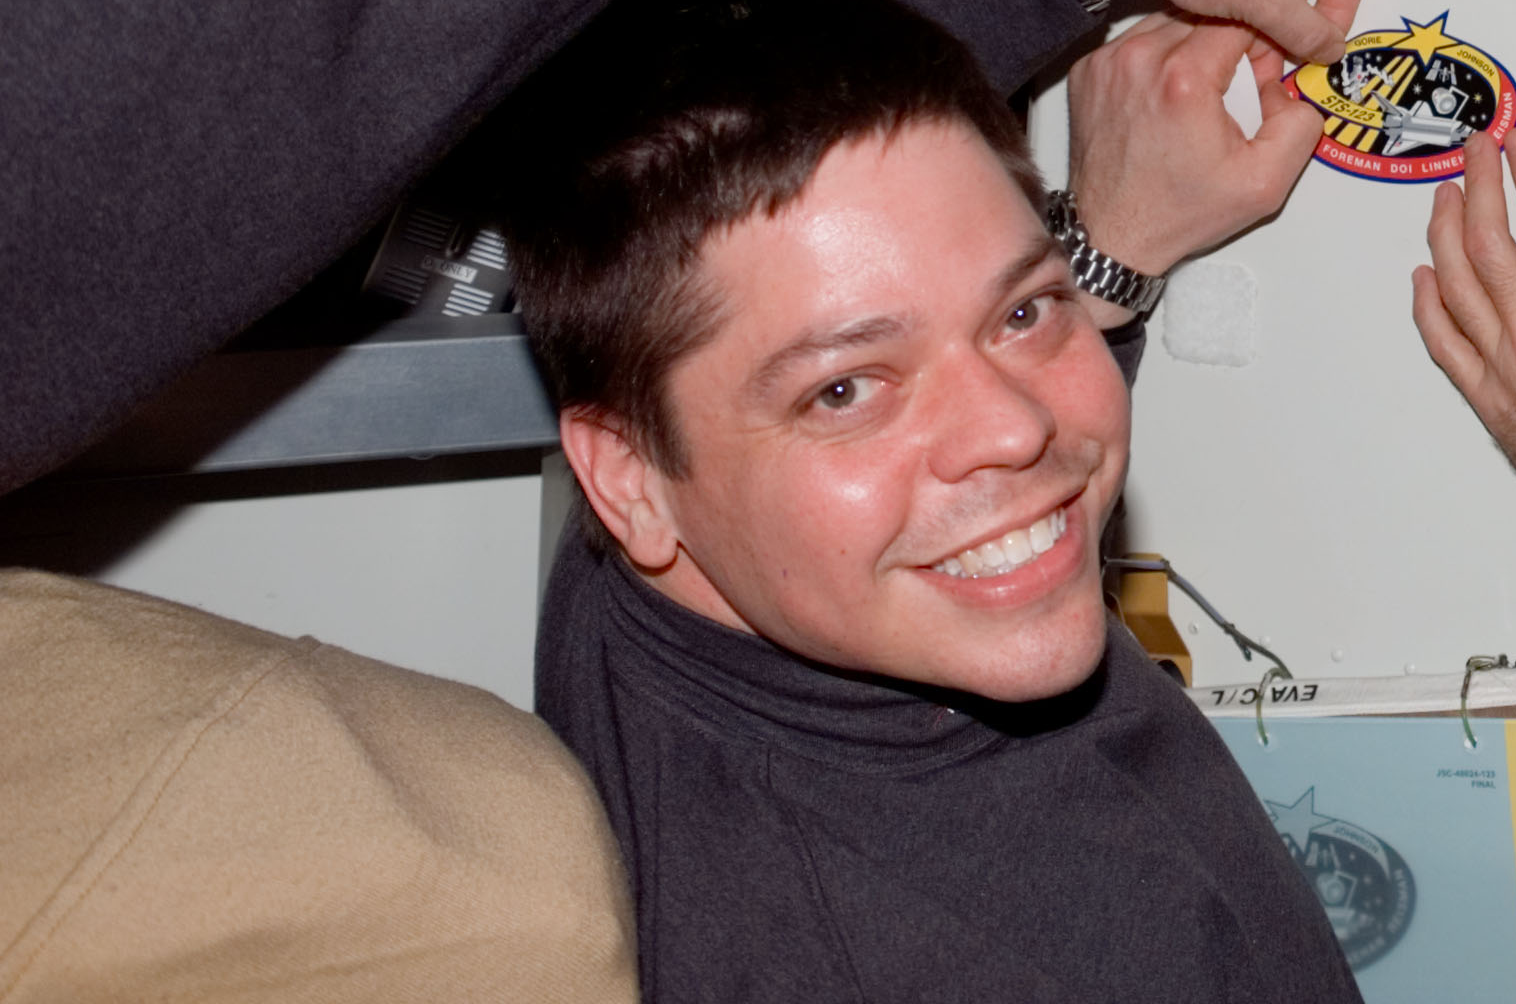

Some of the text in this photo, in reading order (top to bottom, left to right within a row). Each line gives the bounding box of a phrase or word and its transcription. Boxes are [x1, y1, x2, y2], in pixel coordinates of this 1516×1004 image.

[1456, 48, 1496, 78] JOHNSON
[1319, 94, 1376, 122] STS-123
[1322, 143, 1381, 172] FOREMAN
[1390, 162, 1412, 174] DOI
[1271, 684, 1319, 703] EVA
[1471, 780, 1496, 789] FINAL
